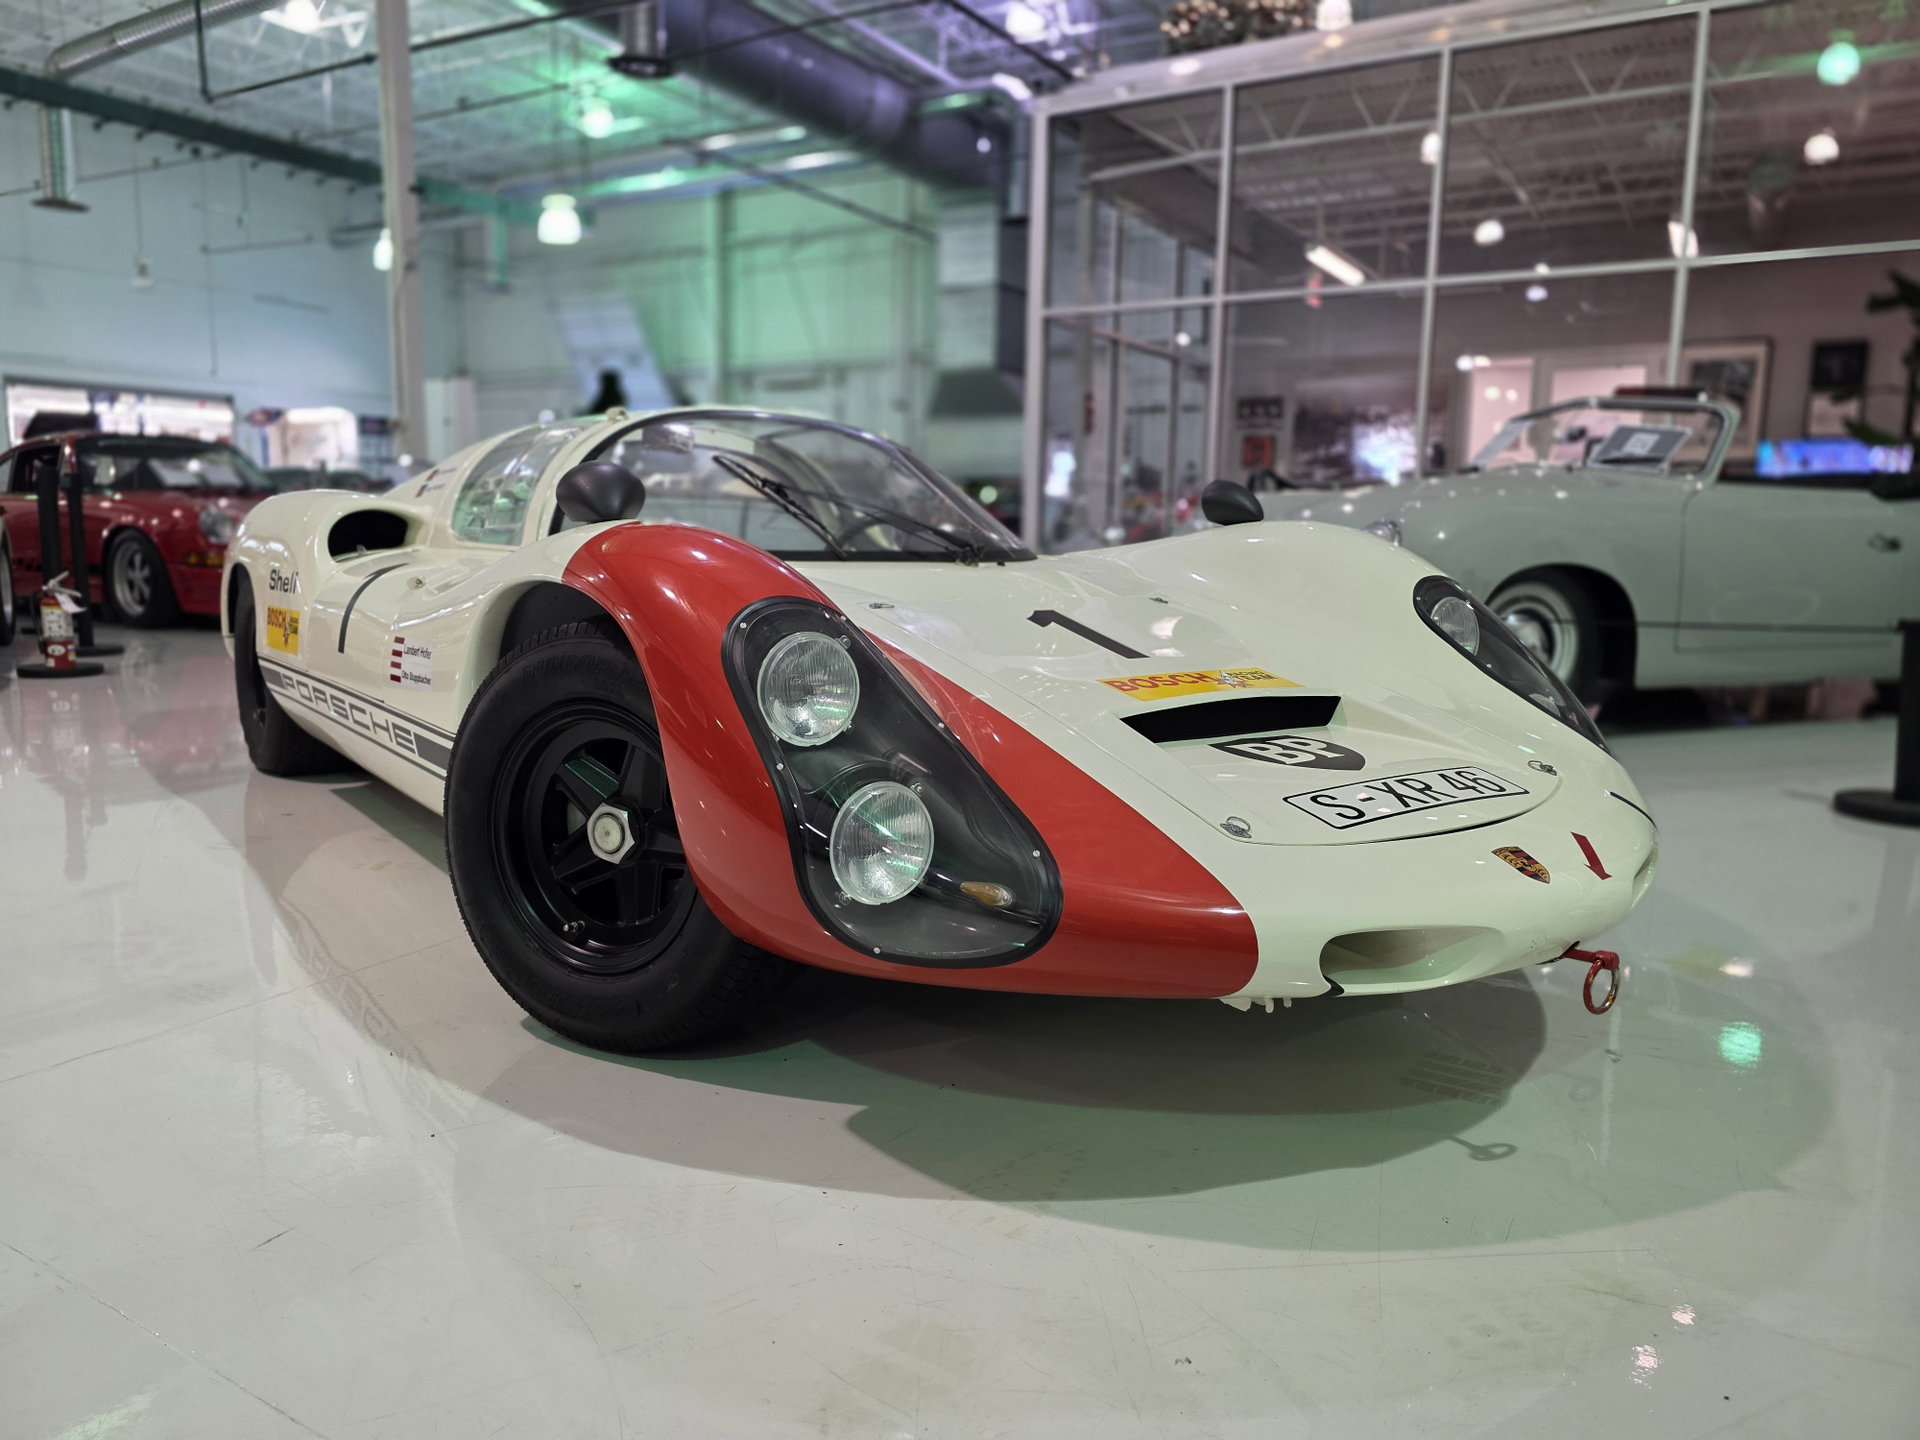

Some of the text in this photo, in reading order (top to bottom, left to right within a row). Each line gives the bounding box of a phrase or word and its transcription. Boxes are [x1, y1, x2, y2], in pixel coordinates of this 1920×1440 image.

[269, 568, 299, 594] Shell
[267, 606, 287, 630] BOSCH
[1026, 609, 1151, 659] 1
[1103, 671, 1217, 693] BOSCH
[283, 674, 417, 755] PORSCHE
[1224, 738, 1345, 765] BP
[1437, 770, 1507, 795] 46
